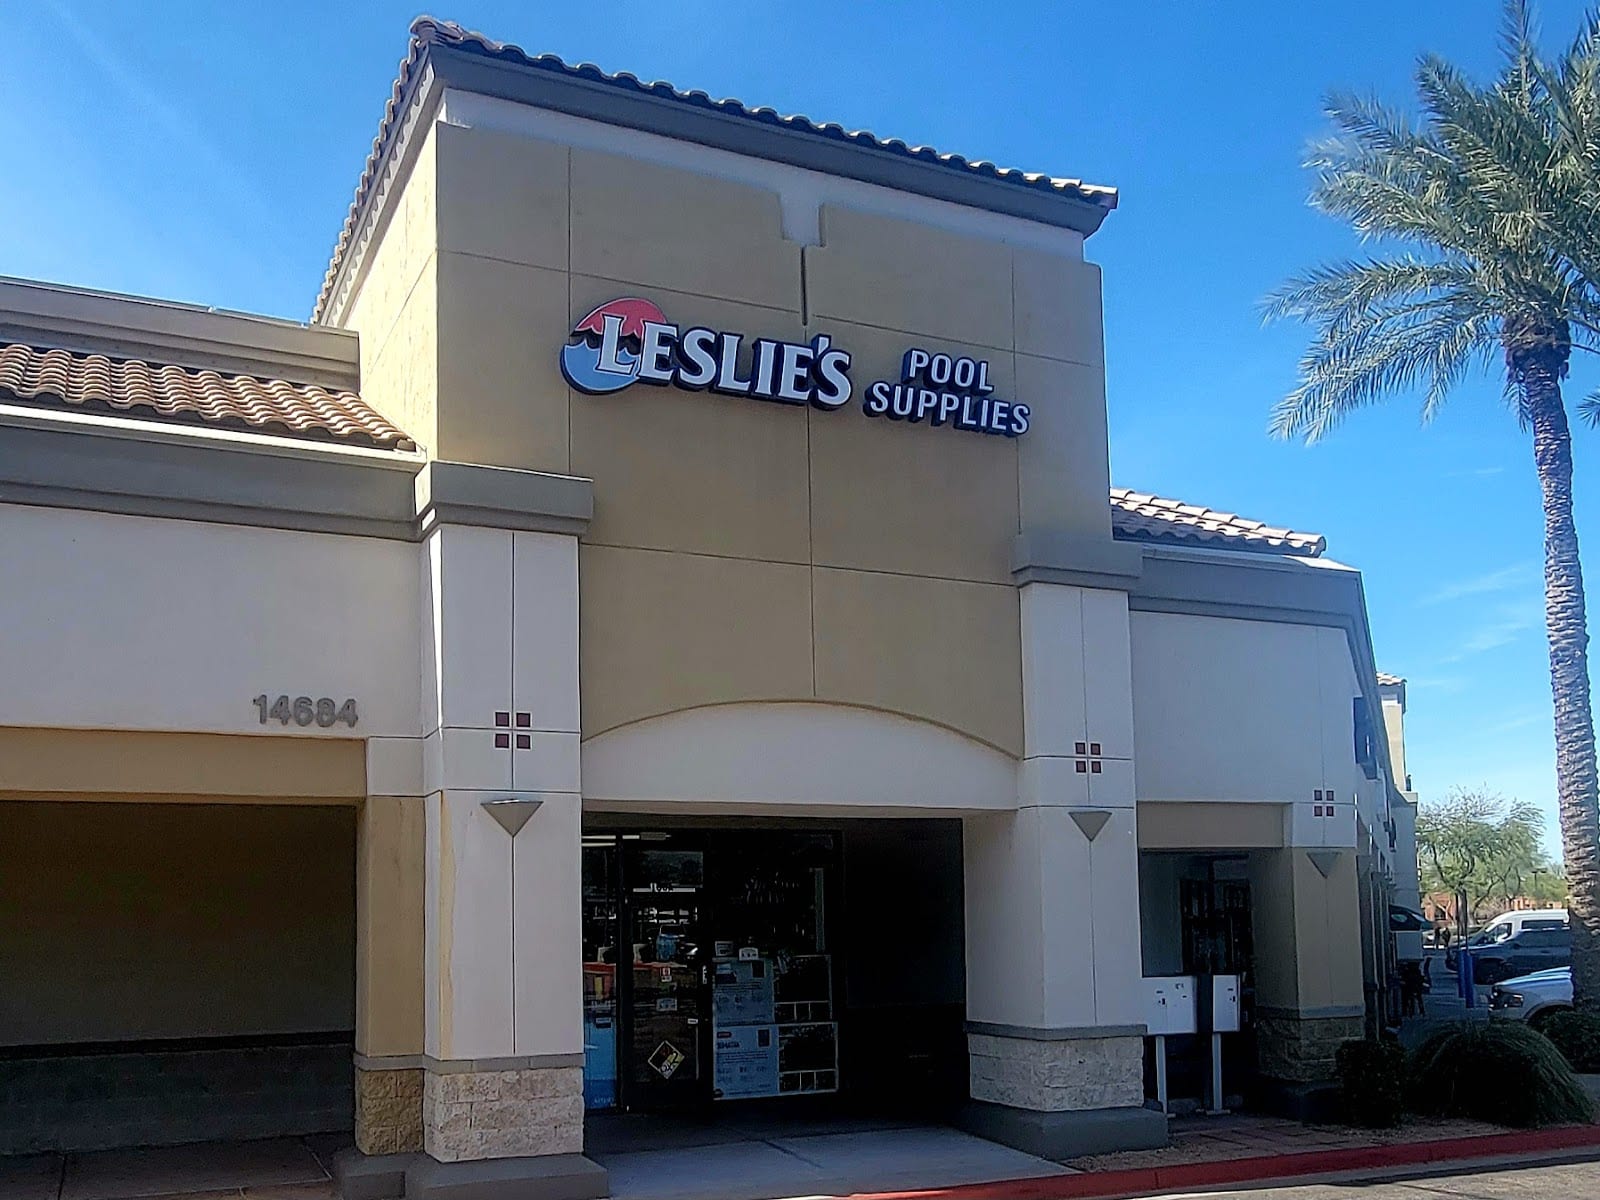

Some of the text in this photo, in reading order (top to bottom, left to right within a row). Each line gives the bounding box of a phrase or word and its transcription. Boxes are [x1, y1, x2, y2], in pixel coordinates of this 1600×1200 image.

[596, 312, 852, 407] LESLIE'S
[906, 349, 995, 393] POOL
[868, 382, 1031, 435] SUPPLIES
[253, 694, 359, 728] 14684
